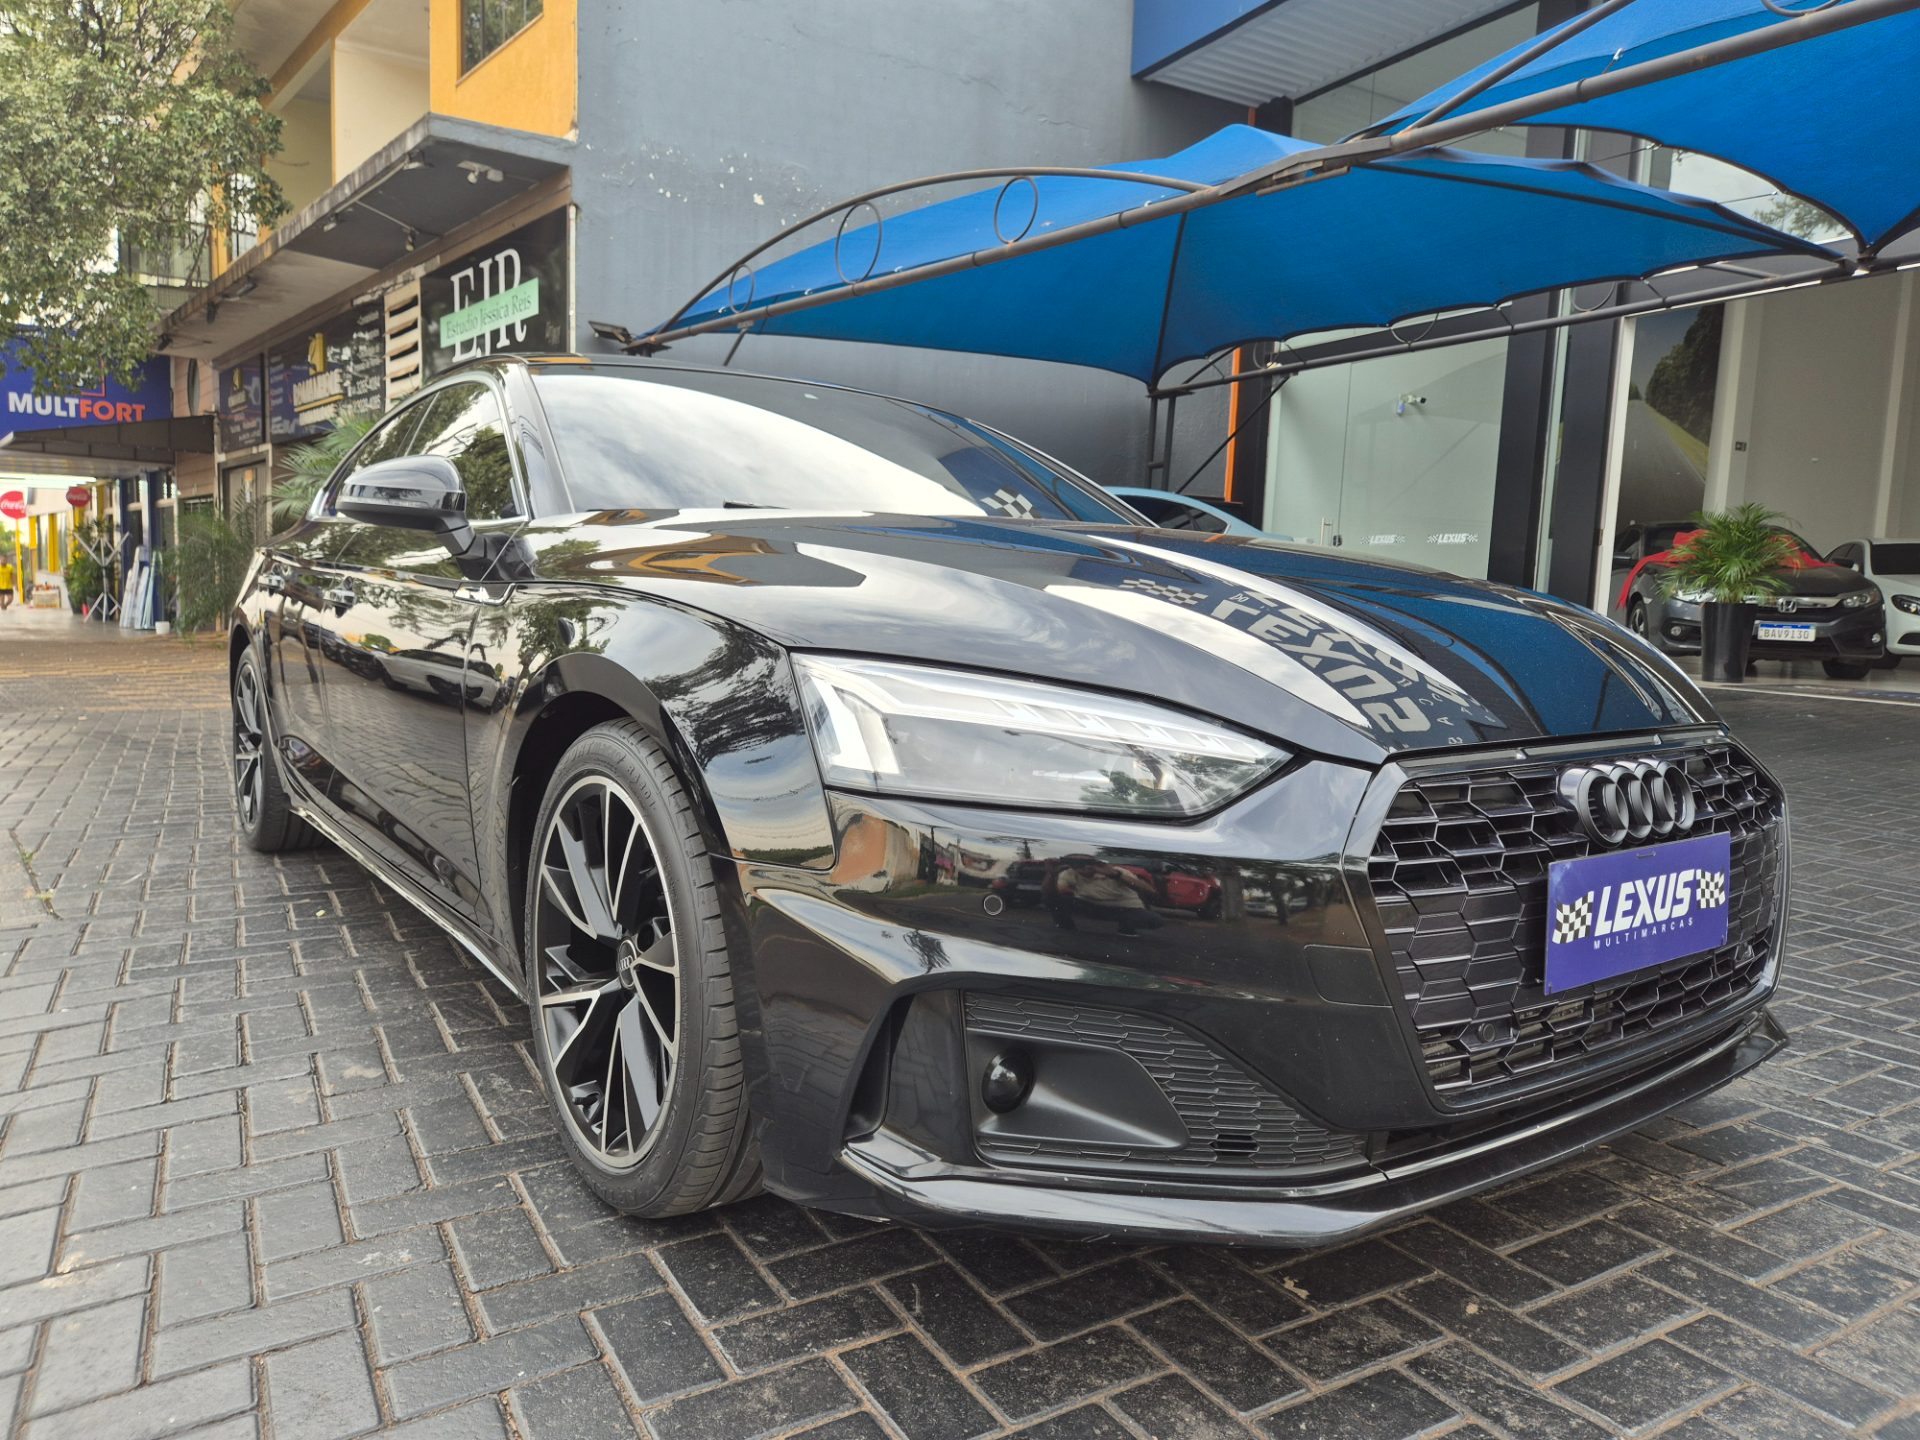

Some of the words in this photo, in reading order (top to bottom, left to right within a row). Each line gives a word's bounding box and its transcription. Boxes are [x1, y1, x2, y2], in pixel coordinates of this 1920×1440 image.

[8, 391, 146, 422] MULTFORT
[1369, 534, 1396, 545] LEXUS
[1438, 533, 1469, 544] LEXUS
[1594, 869, 1695, 937] LEXUS
[1593, 916, 1694, 950] MULTIMARCAS
